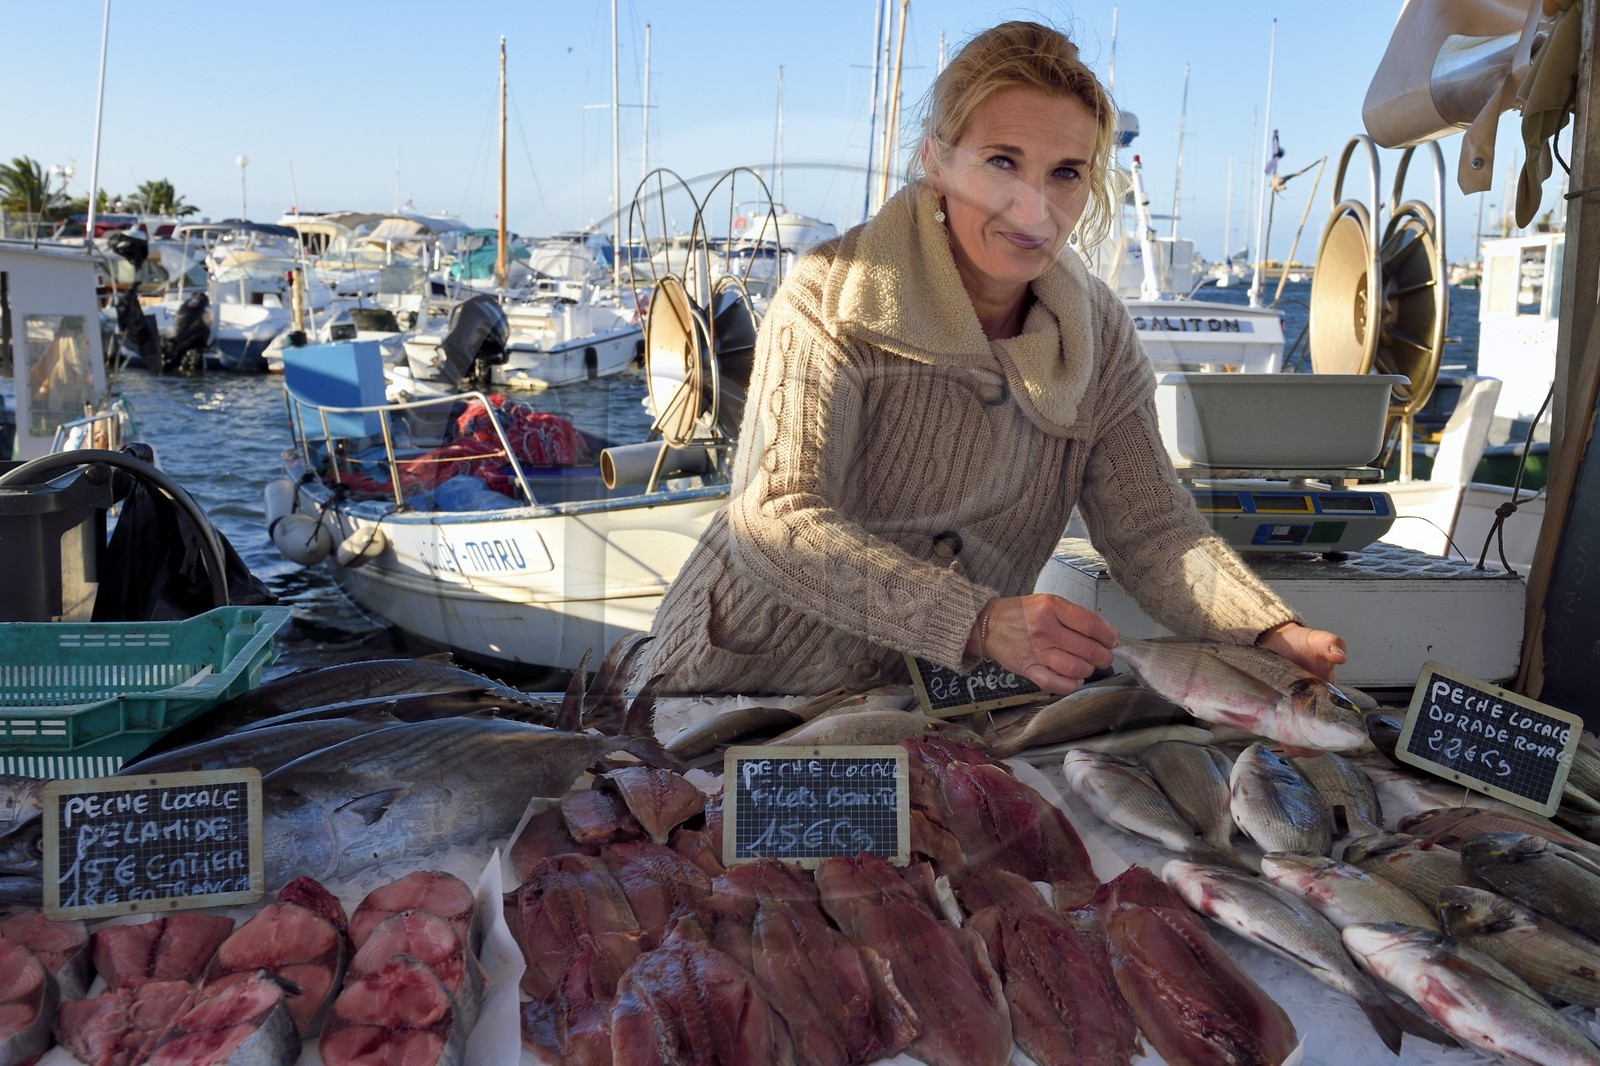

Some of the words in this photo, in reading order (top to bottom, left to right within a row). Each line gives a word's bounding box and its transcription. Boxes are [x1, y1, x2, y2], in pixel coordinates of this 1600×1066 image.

[1429, 704, 1508, 743] DORADE
[1432, 681, 1504, 719] PECHE
[1509, 711, 1571, 746] LOCALE
[742, 760, 823, 791] PECHE
[830, 761, 905, 779] LOCALE
[64, 792, 149, 828] PECHE
[160, 788, 240, 811] LOCALE
